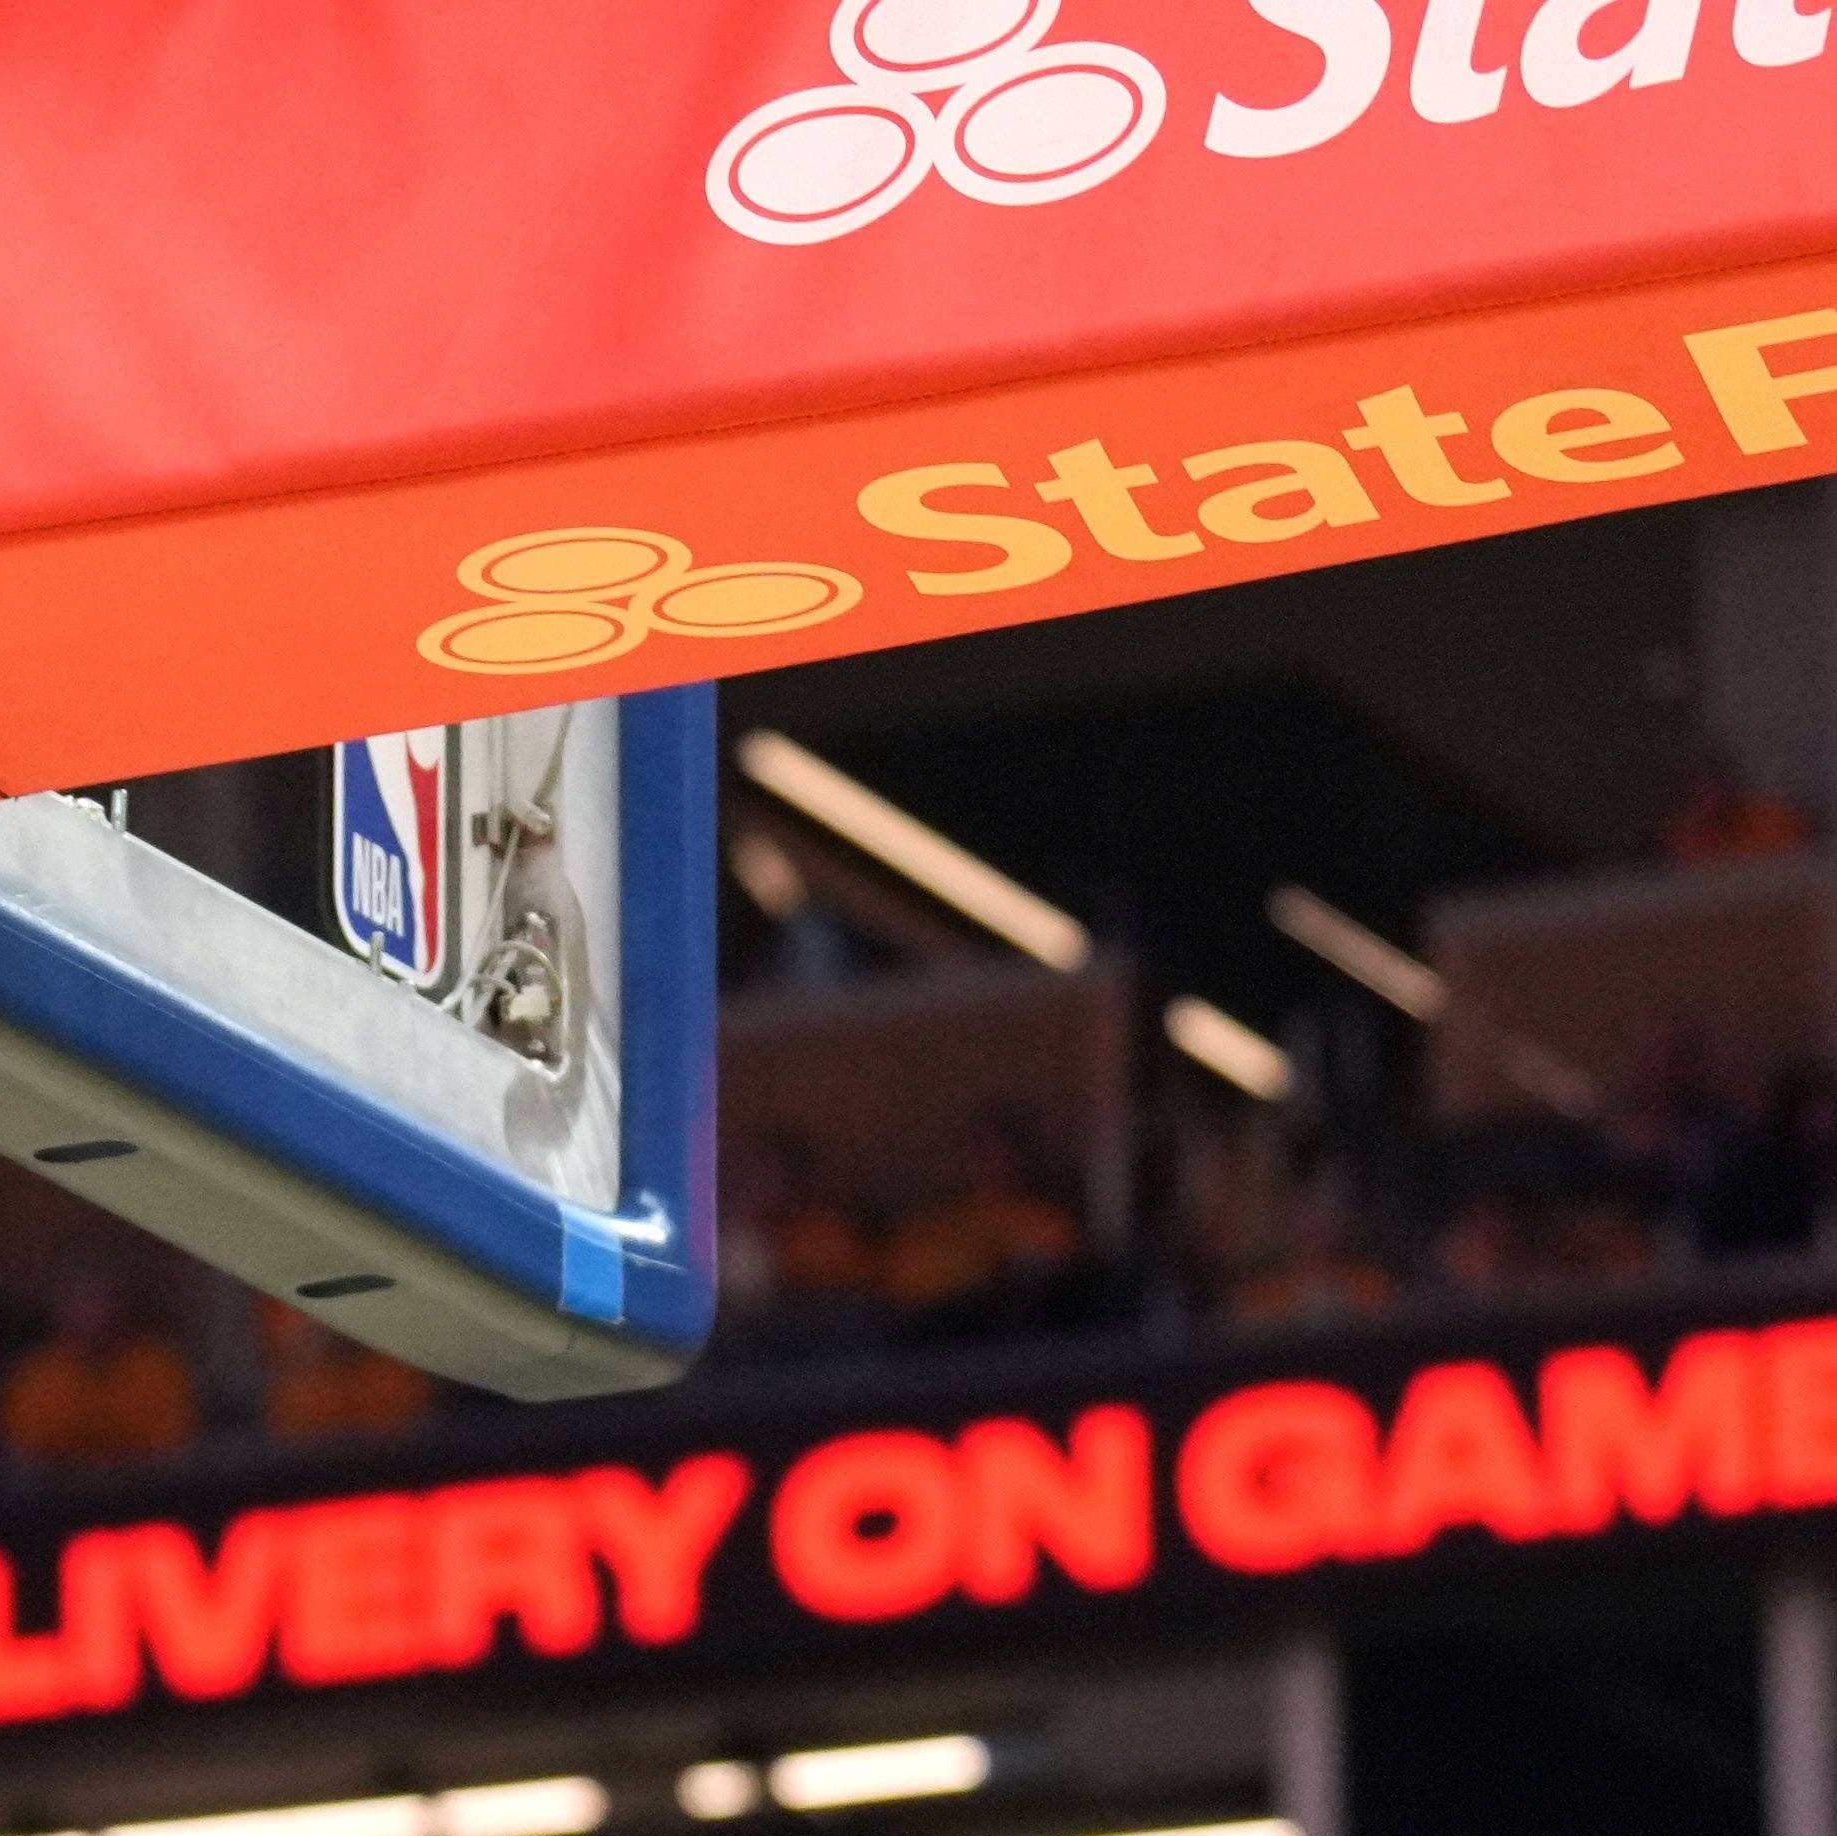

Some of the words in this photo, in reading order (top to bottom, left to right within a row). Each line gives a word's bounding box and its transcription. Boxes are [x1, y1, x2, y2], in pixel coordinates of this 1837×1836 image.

[856, 384, 1686, 596] State
[350, 830, 406, 938] NBA
[769, 1402, 1153, 1624] ON
